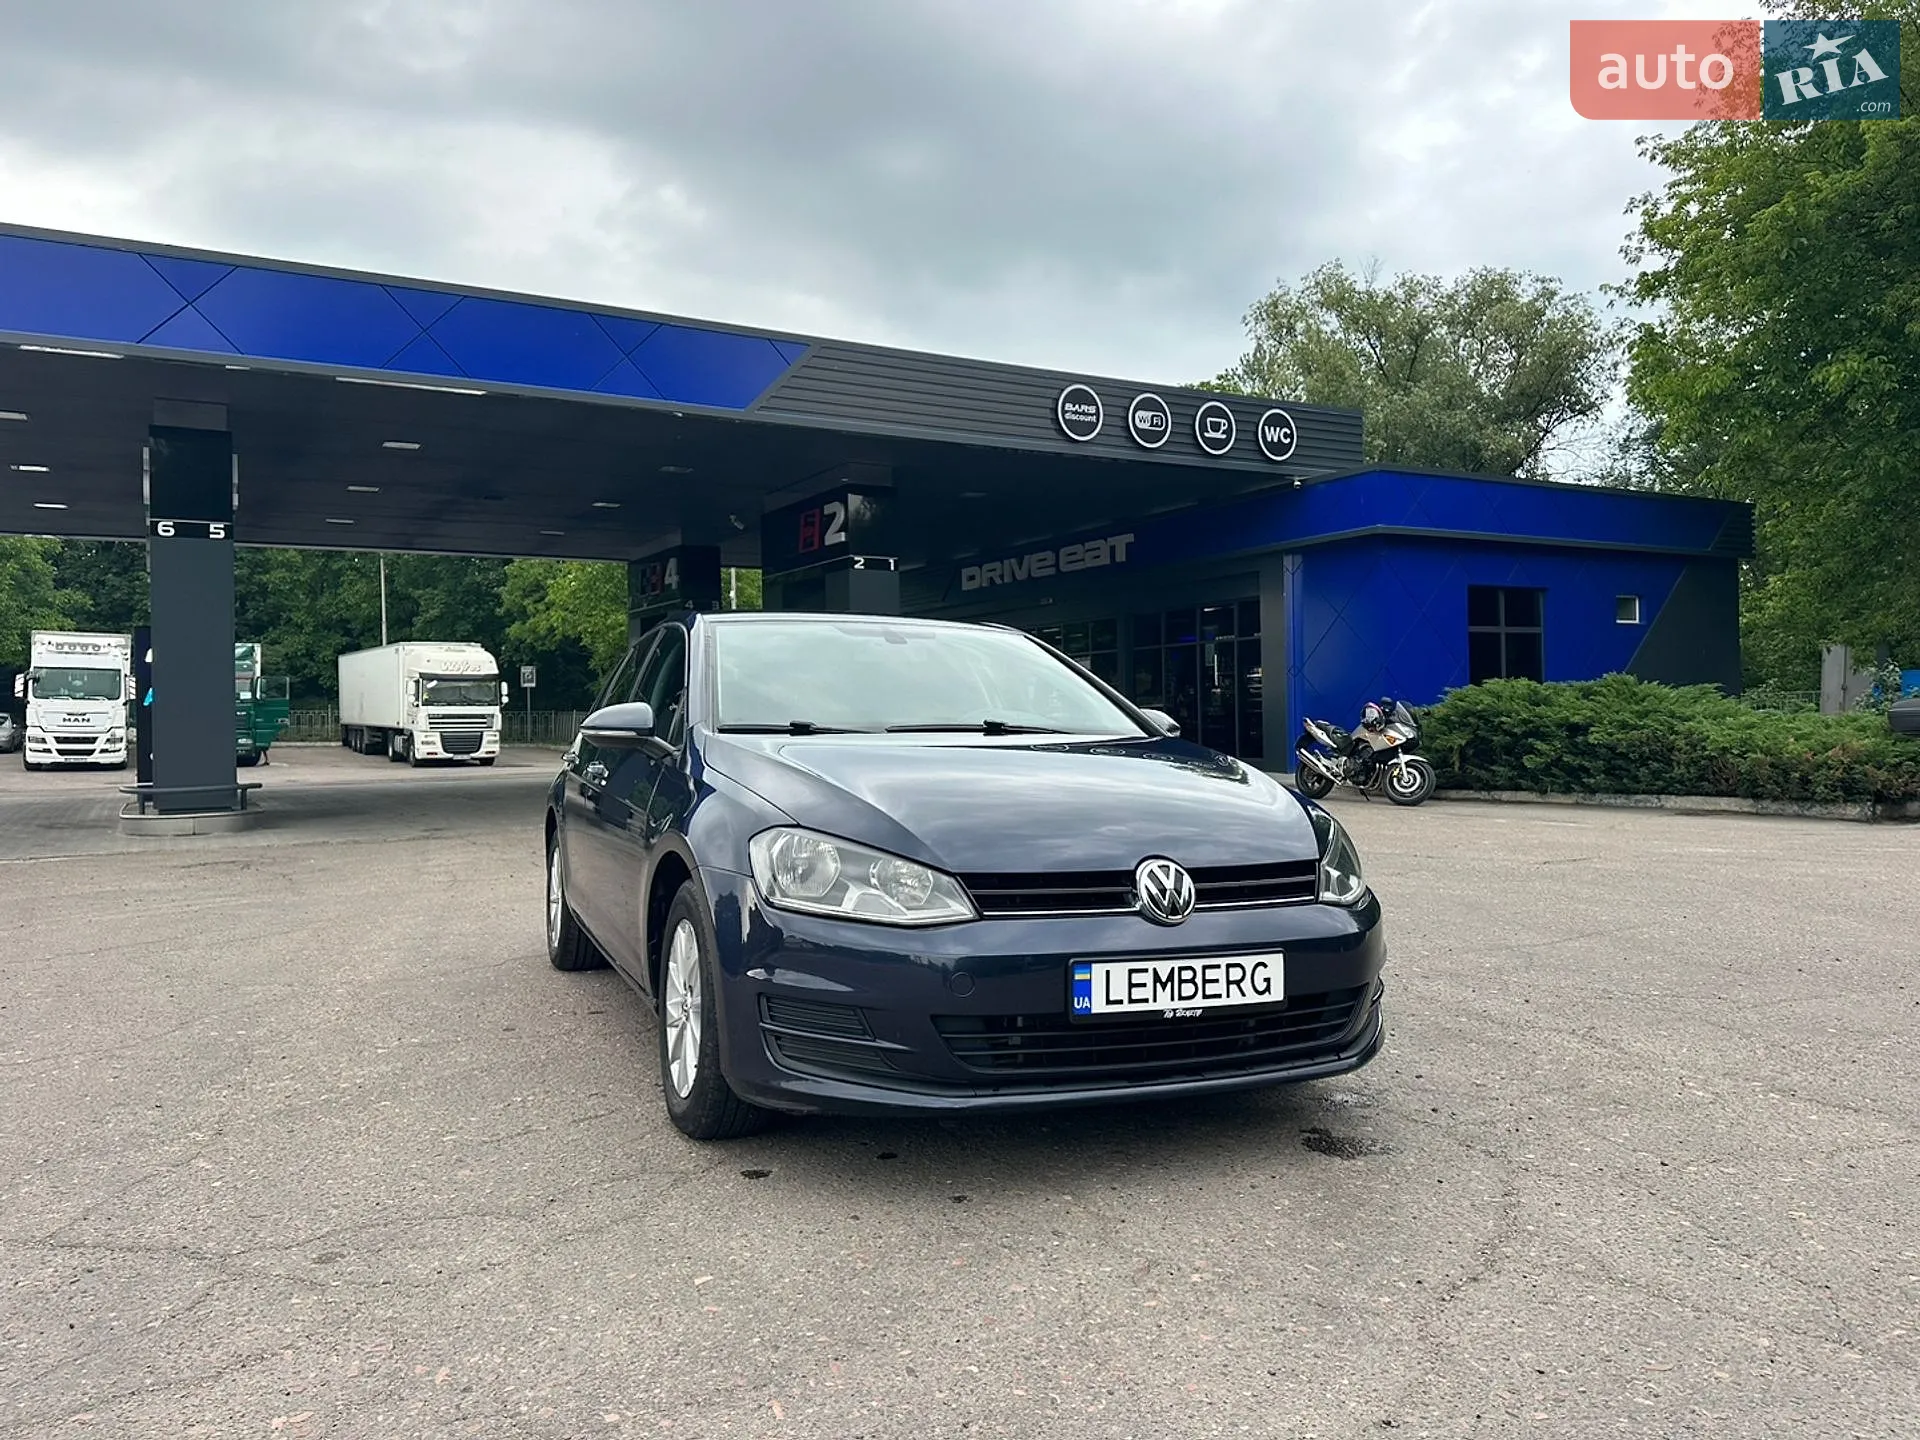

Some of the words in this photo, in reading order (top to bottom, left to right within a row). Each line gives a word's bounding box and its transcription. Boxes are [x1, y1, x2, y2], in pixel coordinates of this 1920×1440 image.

[1064, 402, 1097, 414] BARS
[1064, 412, 1097, 424] discount
[1264, 425, 1291, 444] WC
[157, 521, 176, 537] 6
[209, 523, 226, 539] 5
[823, 501, 846, 546] 2
[854, 557, 865, 569] 2
[888, 558, 895, 571] 1
[664, 557, 680, 590] 4
[684, 600, 694, 609] 4
[1105, 961, 1272, 1006] LEMBERG
[1074, 997, 1091, 1009] UA
